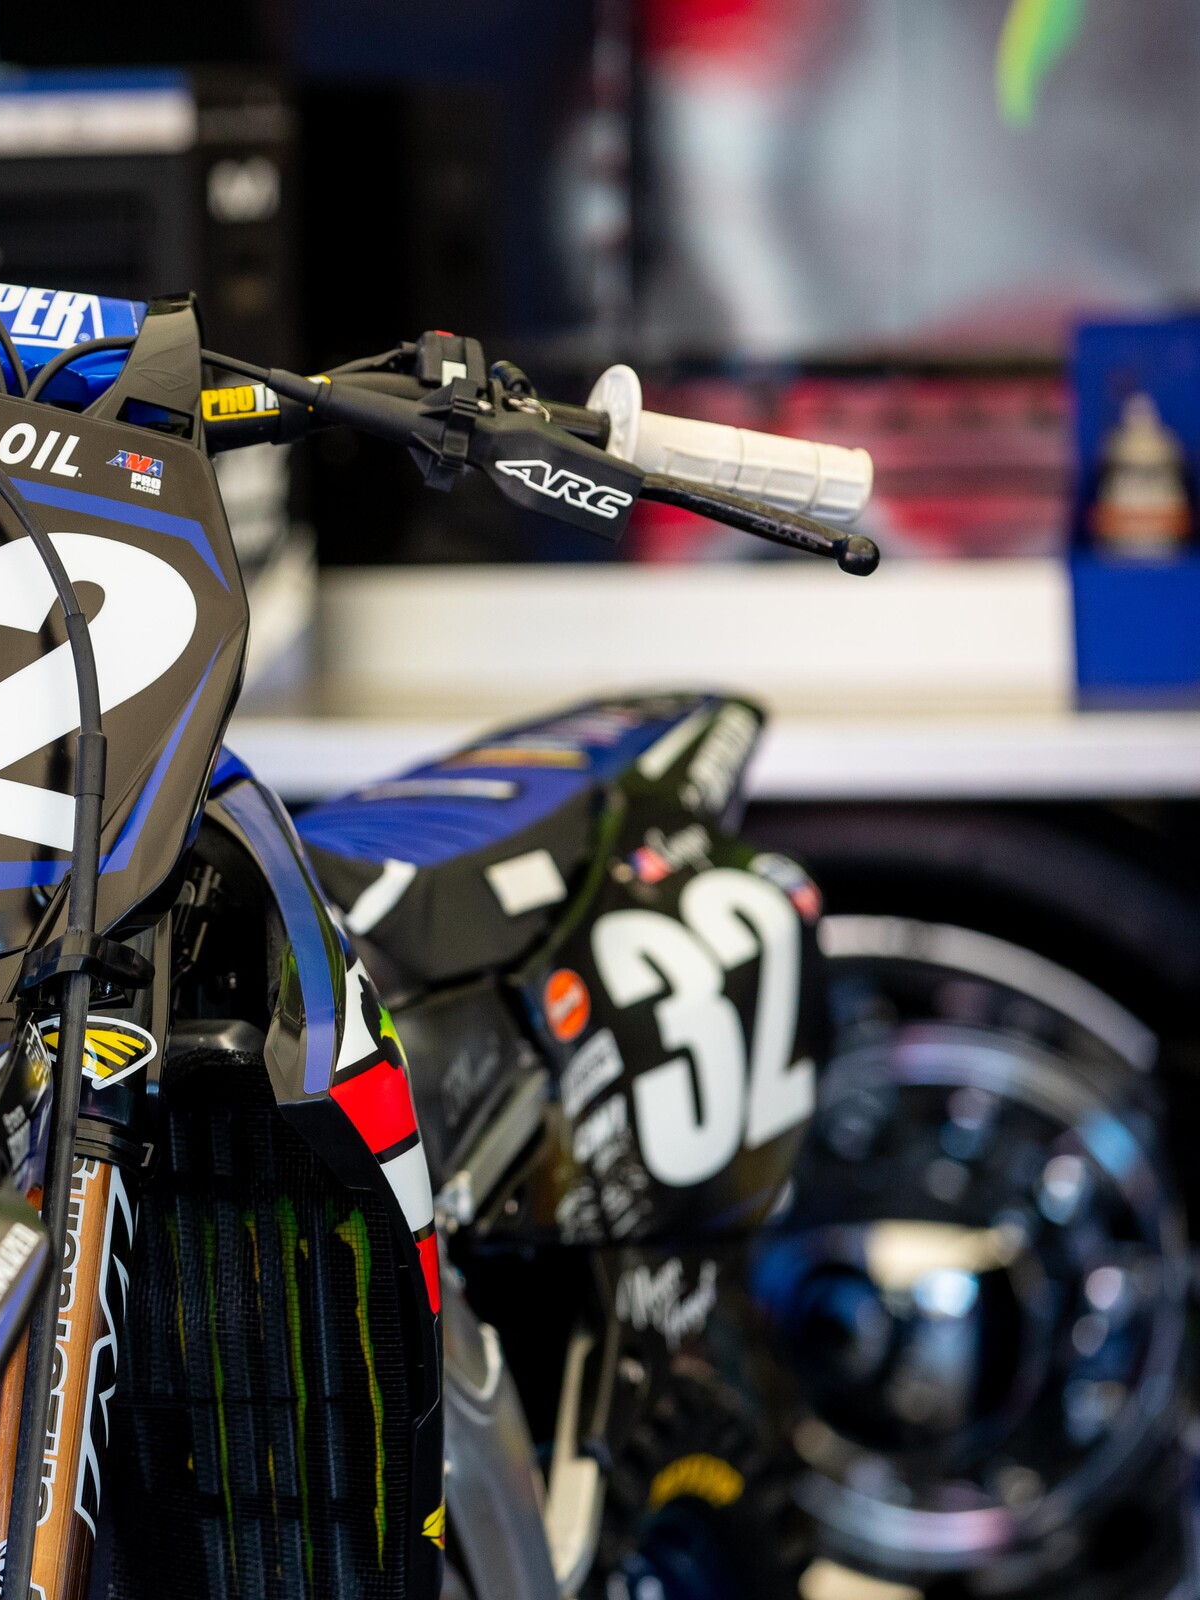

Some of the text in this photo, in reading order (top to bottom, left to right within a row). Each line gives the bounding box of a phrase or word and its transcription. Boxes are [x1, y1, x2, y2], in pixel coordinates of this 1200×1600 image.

[106, 450, 163, 478] AMA
[130, 482, 160, 496] RACING
[131, 472, 161, 490] PRO
[495, 459, 633, 519] ARC
[591, 866, 817, 1188] 32
